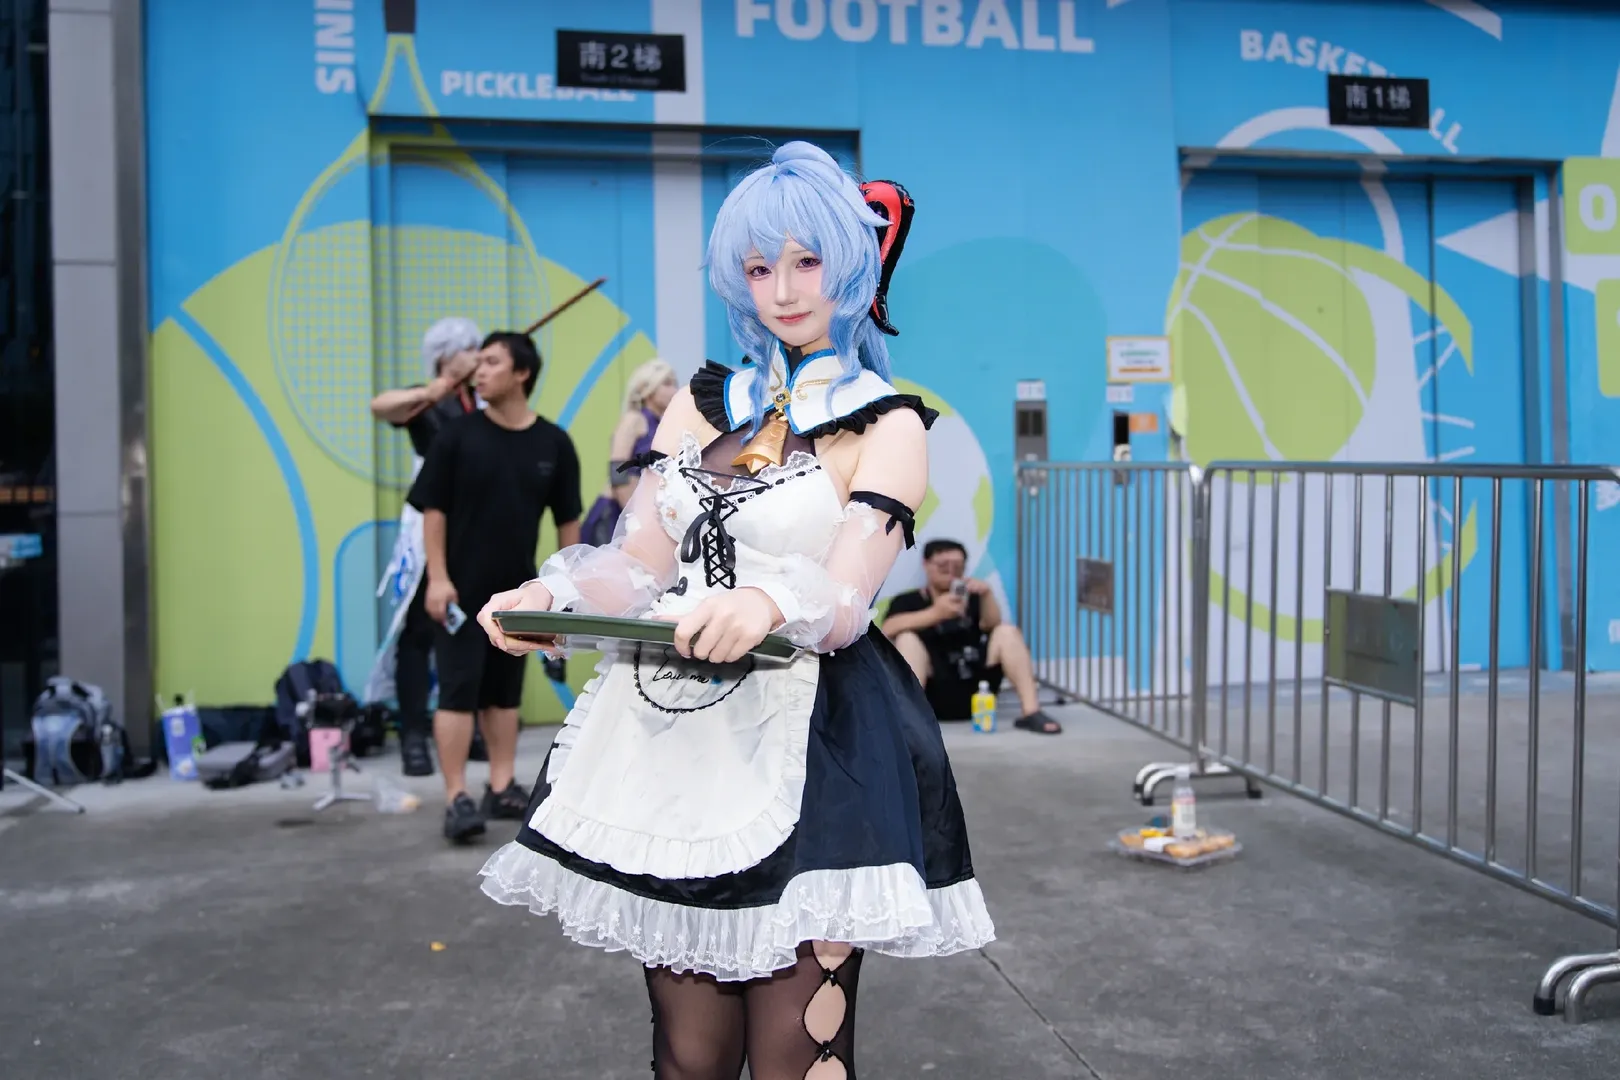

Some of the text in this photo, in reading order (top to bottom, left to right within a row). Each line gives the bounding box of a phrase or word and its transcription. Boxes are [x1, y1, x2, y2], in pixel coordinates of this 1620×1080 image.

[735, 0, 1095, 53] FOOTBALL
[578, 41, 663, 73] 南2梯
[1239, 29, 1463, 154] BASKETLL
